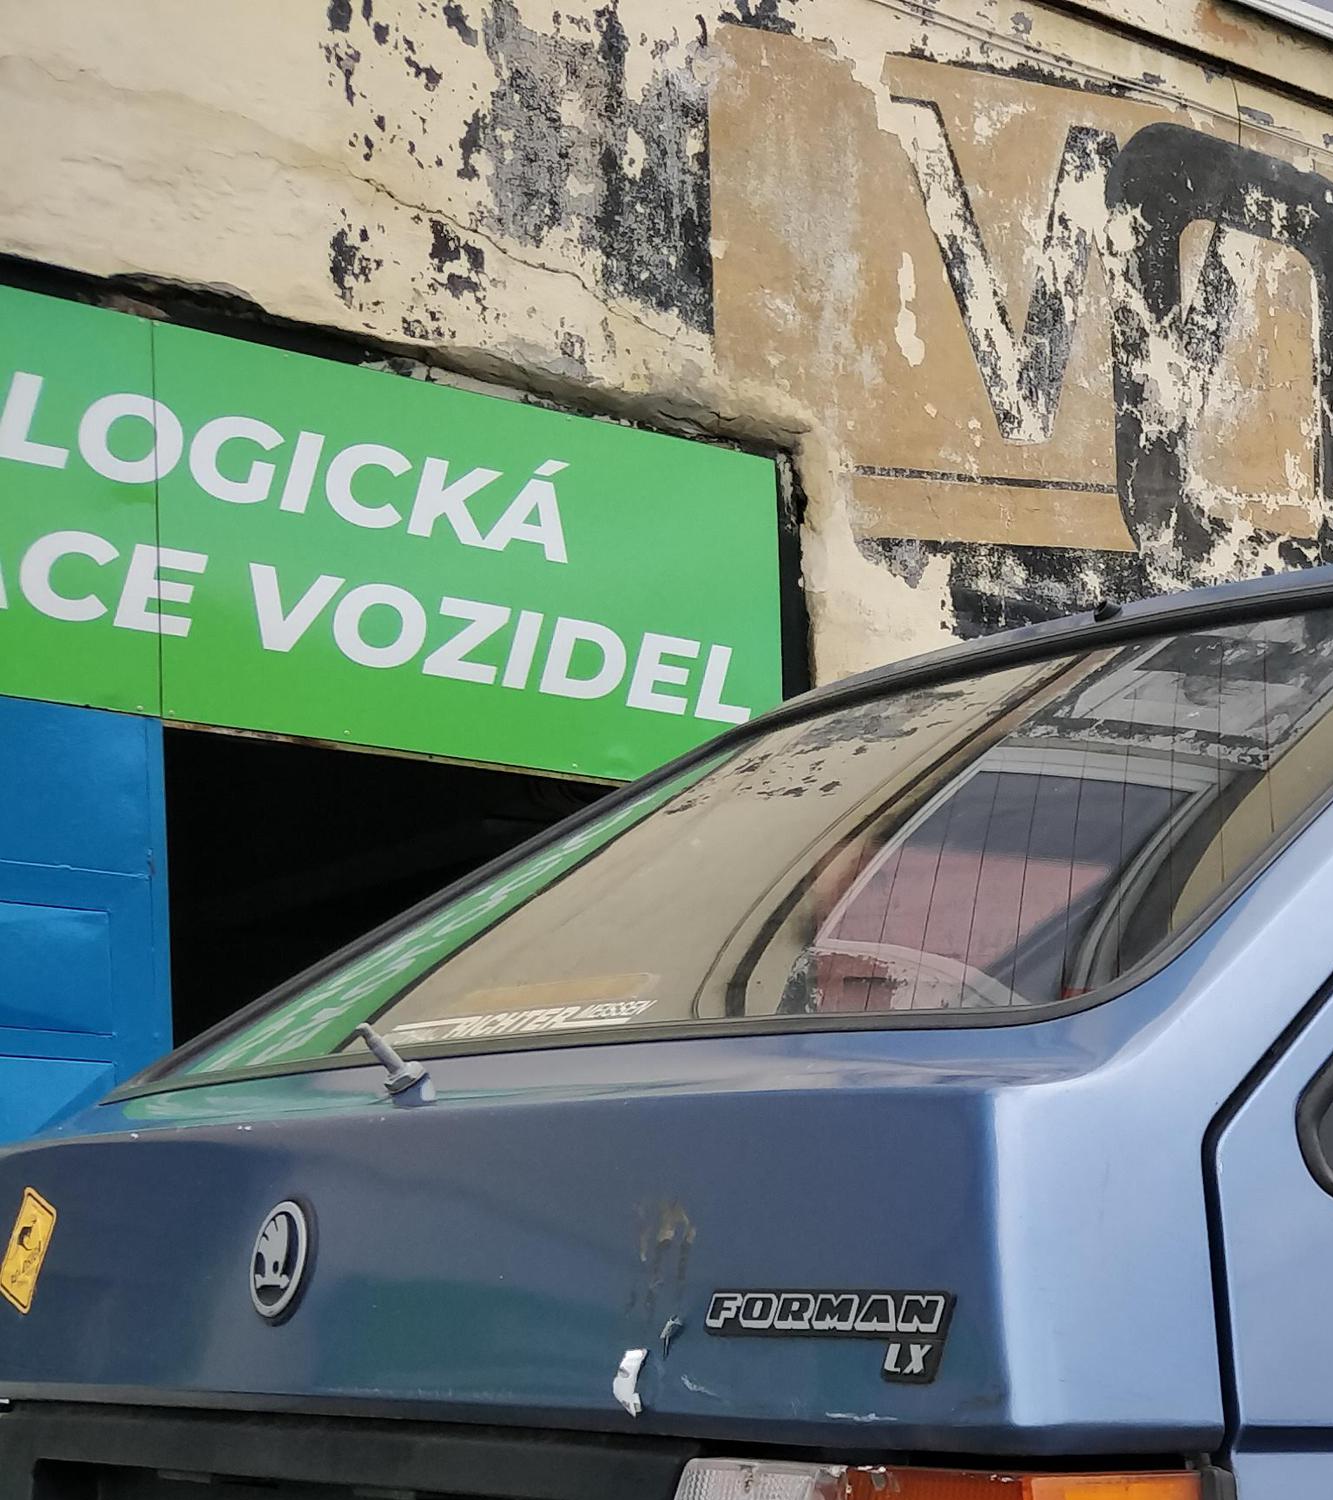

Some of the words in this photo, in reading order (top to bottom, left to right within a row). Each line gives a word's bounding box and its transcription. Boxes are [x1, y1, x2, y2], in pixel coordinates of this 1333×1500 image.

[0, 530, 209, 637] CE
[249, 562, 752, 724] VOZIDEL
[442, 1005, 580, 1039] RICHTER
[706, 1292, 946, 1333] FORMAN
[883, 1343, 932, 1375] LX
